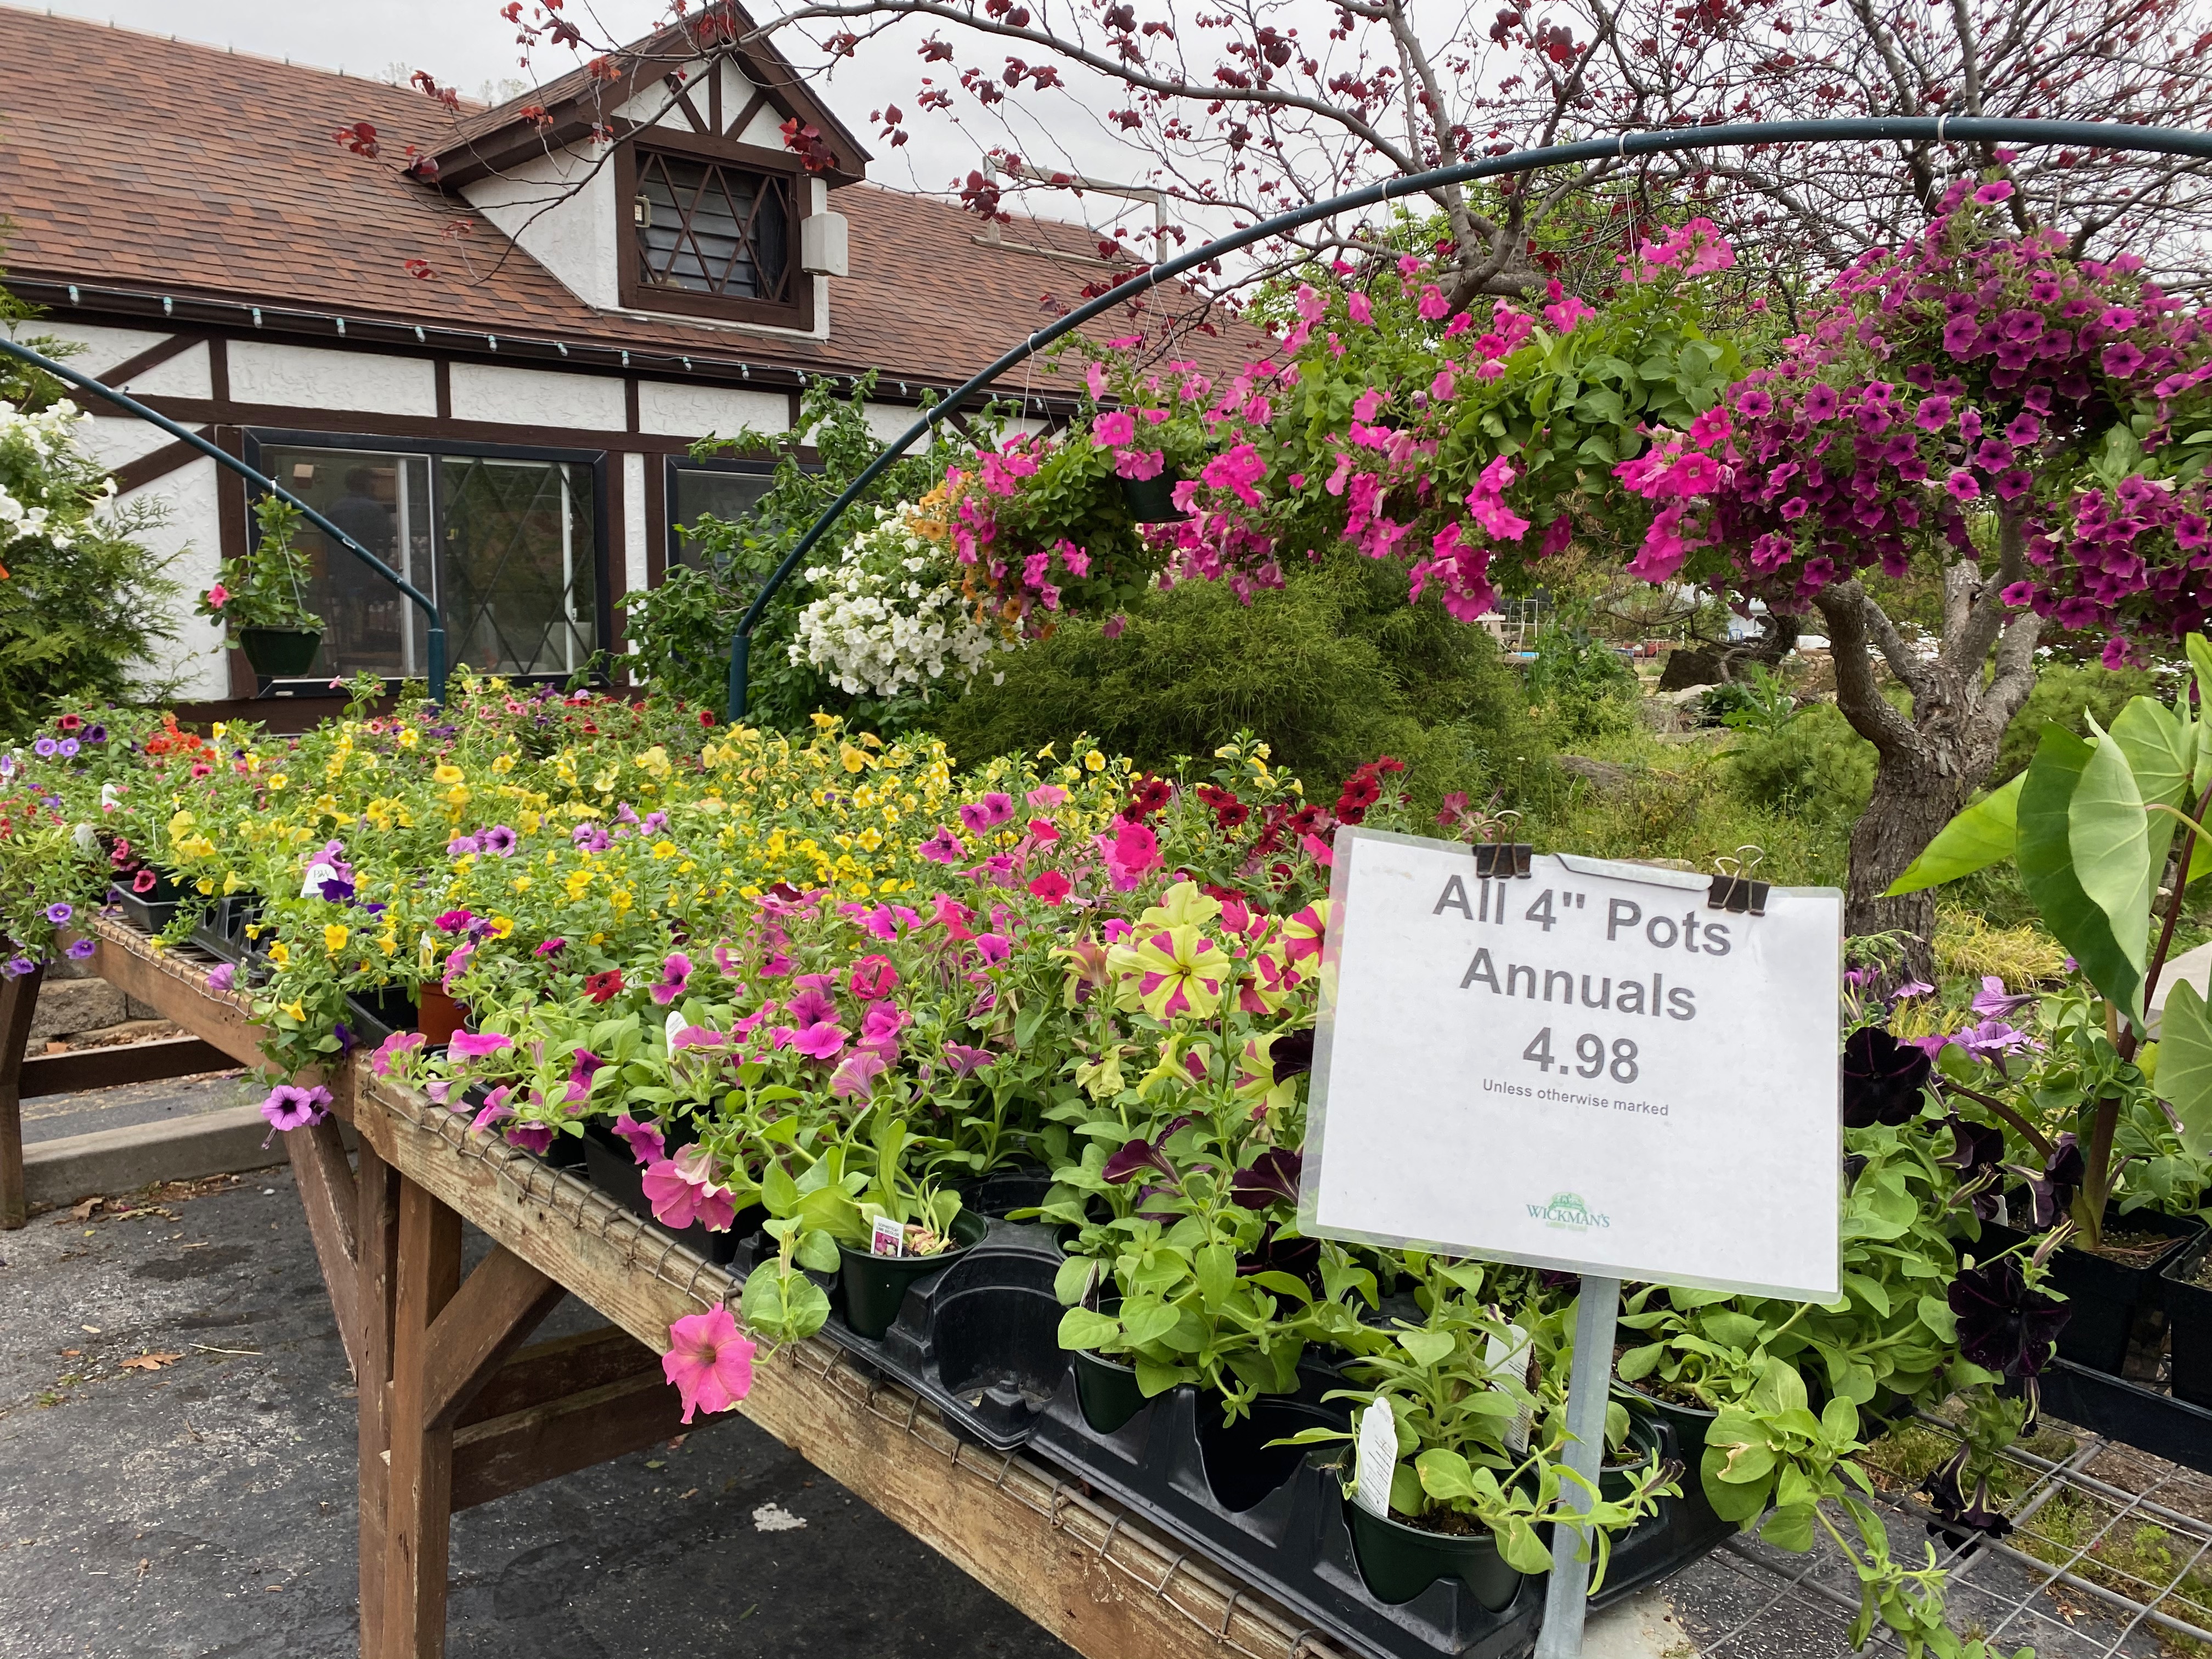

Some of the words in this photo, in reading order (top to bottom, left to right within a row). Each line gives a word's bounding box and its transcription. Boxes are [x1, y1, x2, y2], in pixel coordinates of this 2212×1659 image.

[1432, 874, 1506, 925] All
[1525, 889, 1585, 932] 4"
[1607, 898, 1731, 957] Pots
[1459, 947, 1696, 1021] Annuals
[1523, 1027, 1639, 1084] 4.98
[1483, 1079, 1532, 1097] Unless
[1537, 1088, 1609, 1108] otherwise
[1613, 1099, 1669, 1116] marked
[1526, 1204, 1610, 1228] WICKMAN'S
